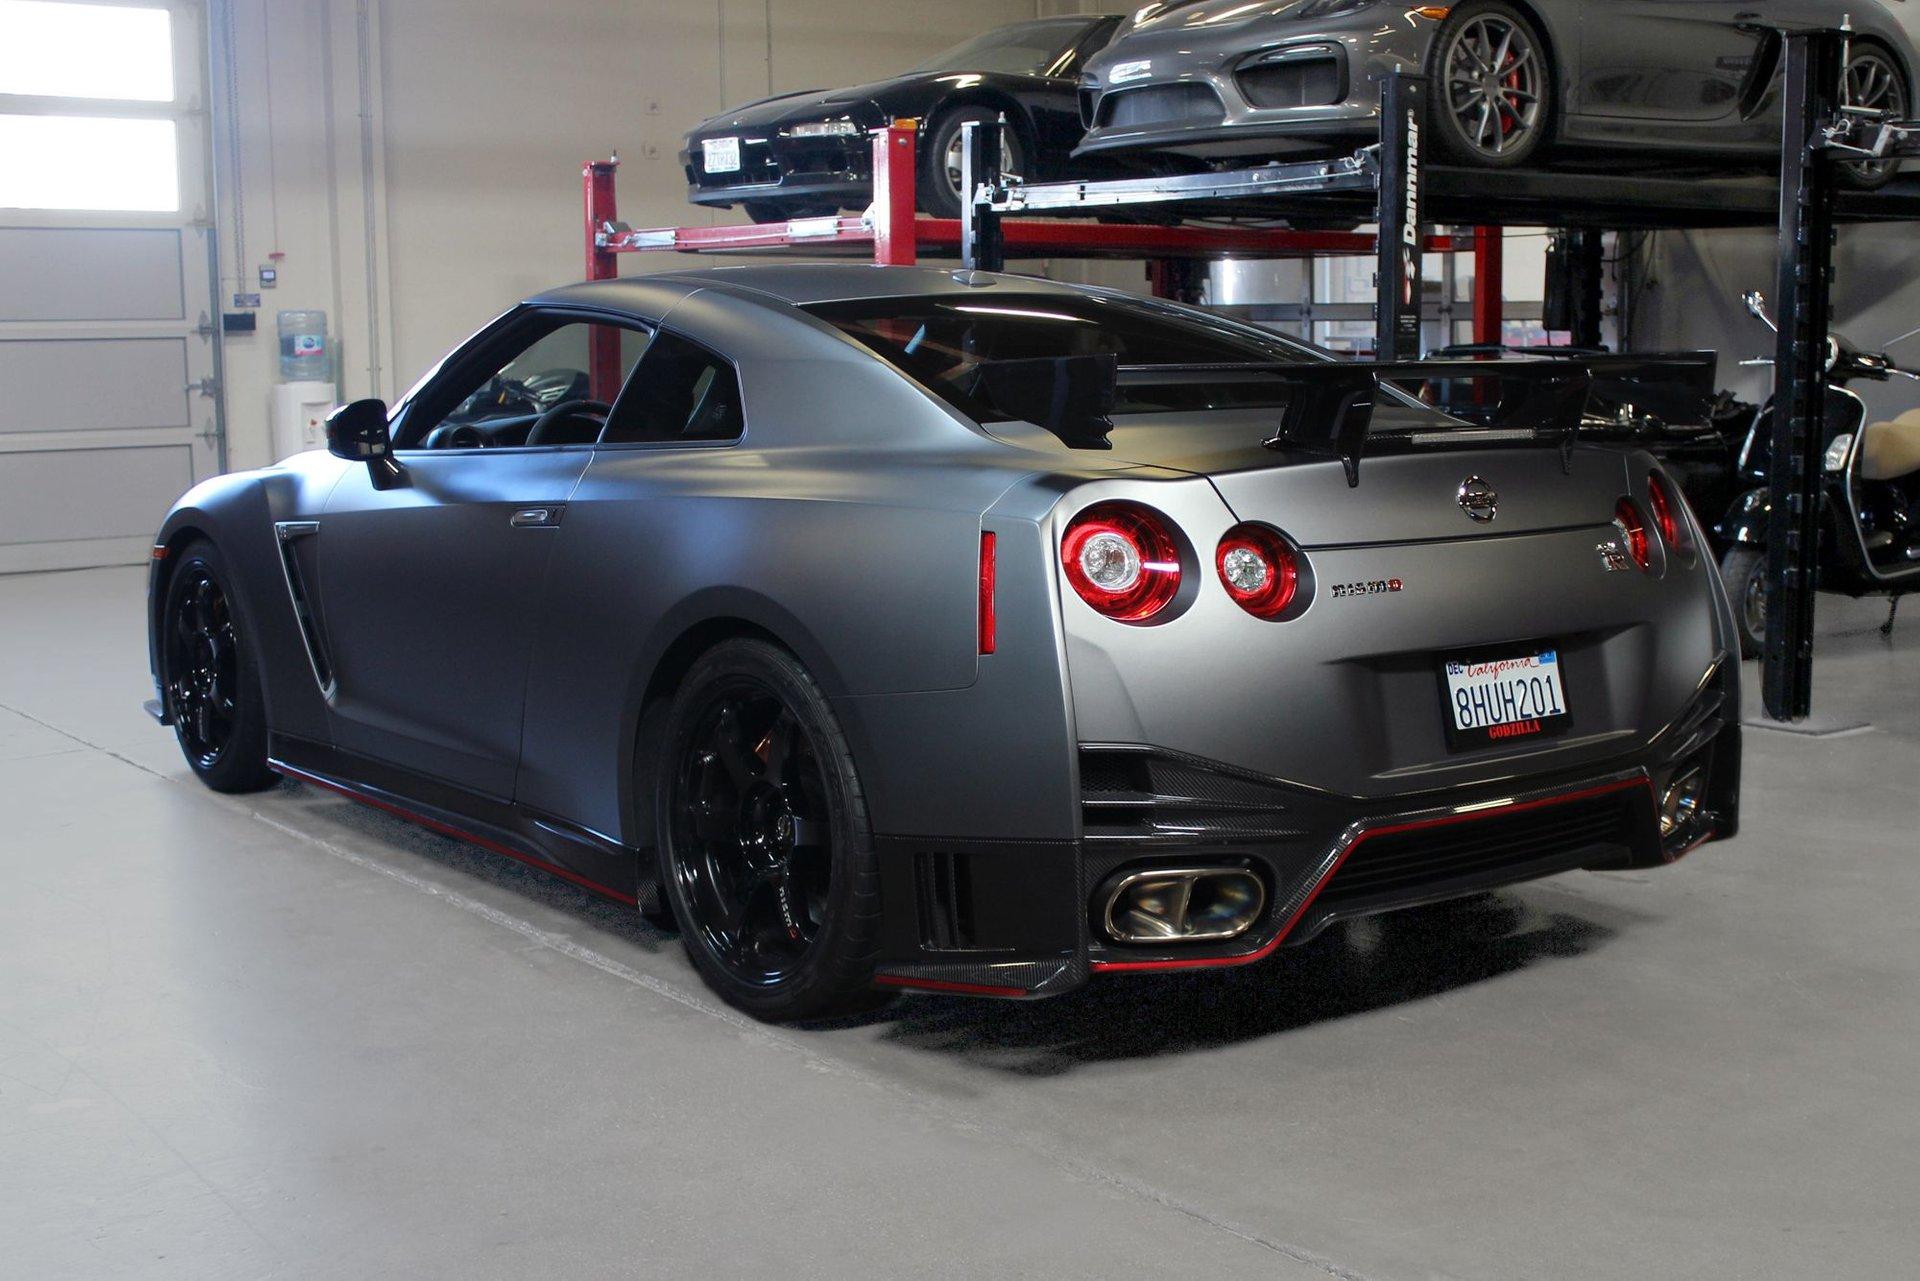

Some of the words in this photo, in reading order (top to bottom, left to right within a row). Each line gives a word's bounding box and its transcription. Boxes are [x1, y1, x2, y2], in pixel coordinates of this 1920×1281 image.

[1403, 118, 1419, 246] Dannmar
[1467, 656, 1540, 680] California
[1456, 675, 1561, 728] 8HUH201
[1489, 719, 1541, 739] GODZILLA
